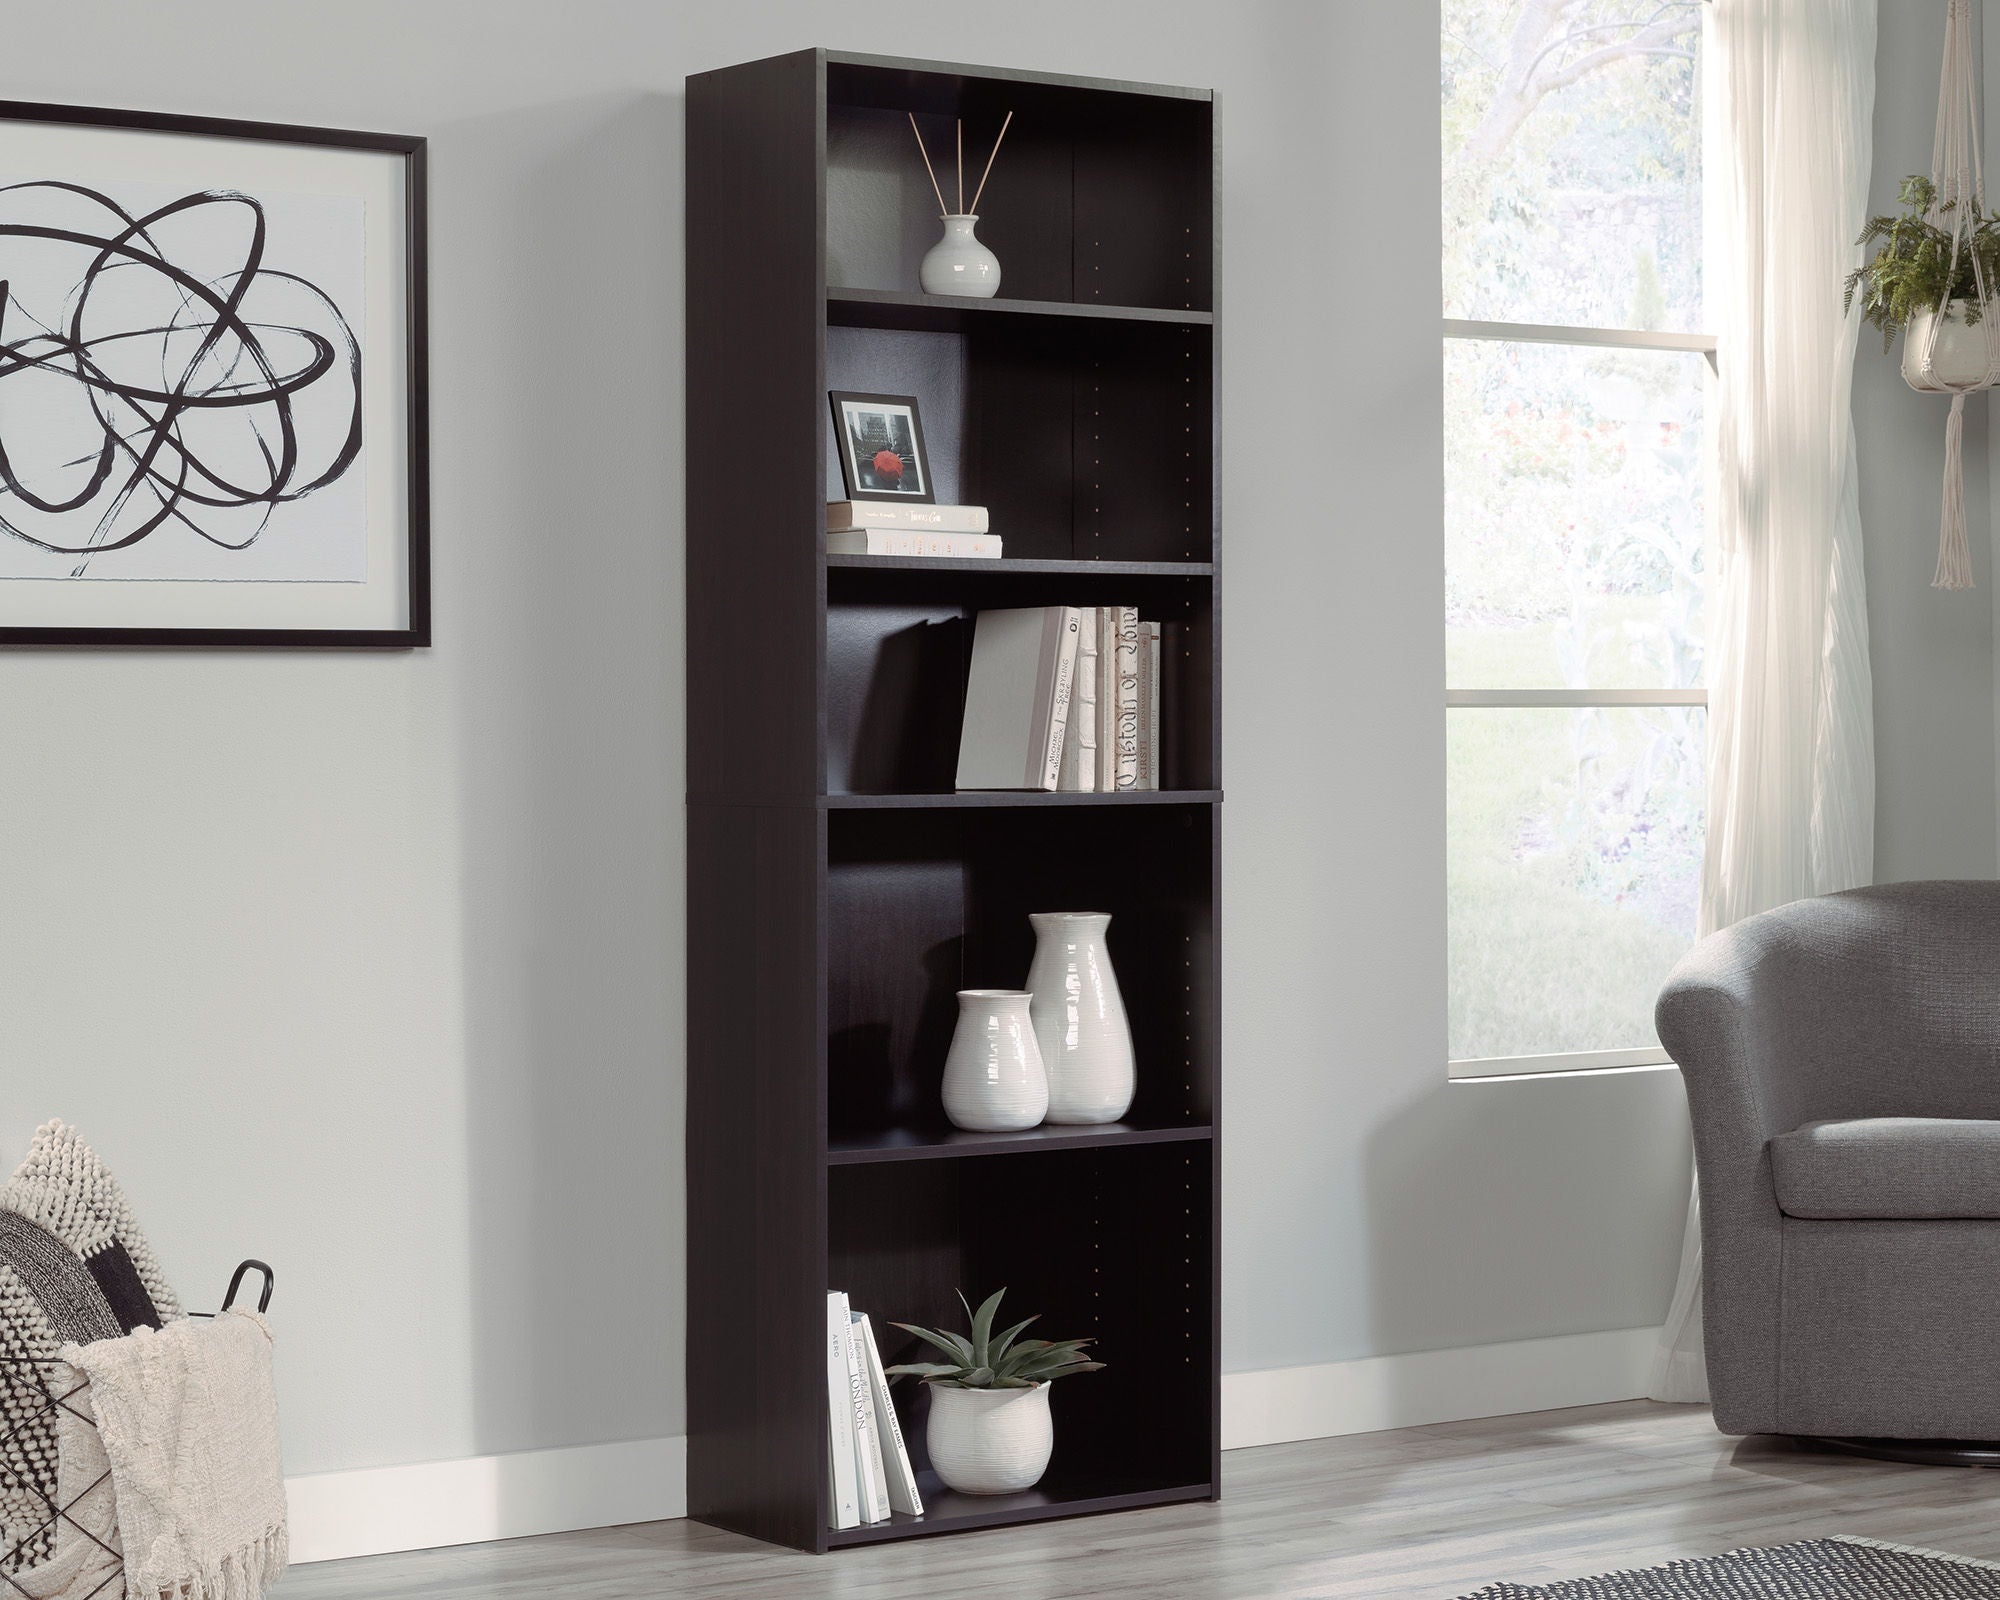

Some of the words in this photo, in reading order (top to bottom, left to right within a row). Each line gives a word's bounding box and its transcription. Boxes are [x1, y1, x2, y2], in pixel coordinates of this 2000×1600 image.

[1140, 740, 1148, 780] KIRSTI
[832, 1334, 840, 1358] AERO
[850, 1374, 866, 1430] LONDON
[881, 1384, 892, 1410] CHARLES
[894, 1429, 903, 1449] EAMES
[910, 1486, 920, 1510] TASCHEN
